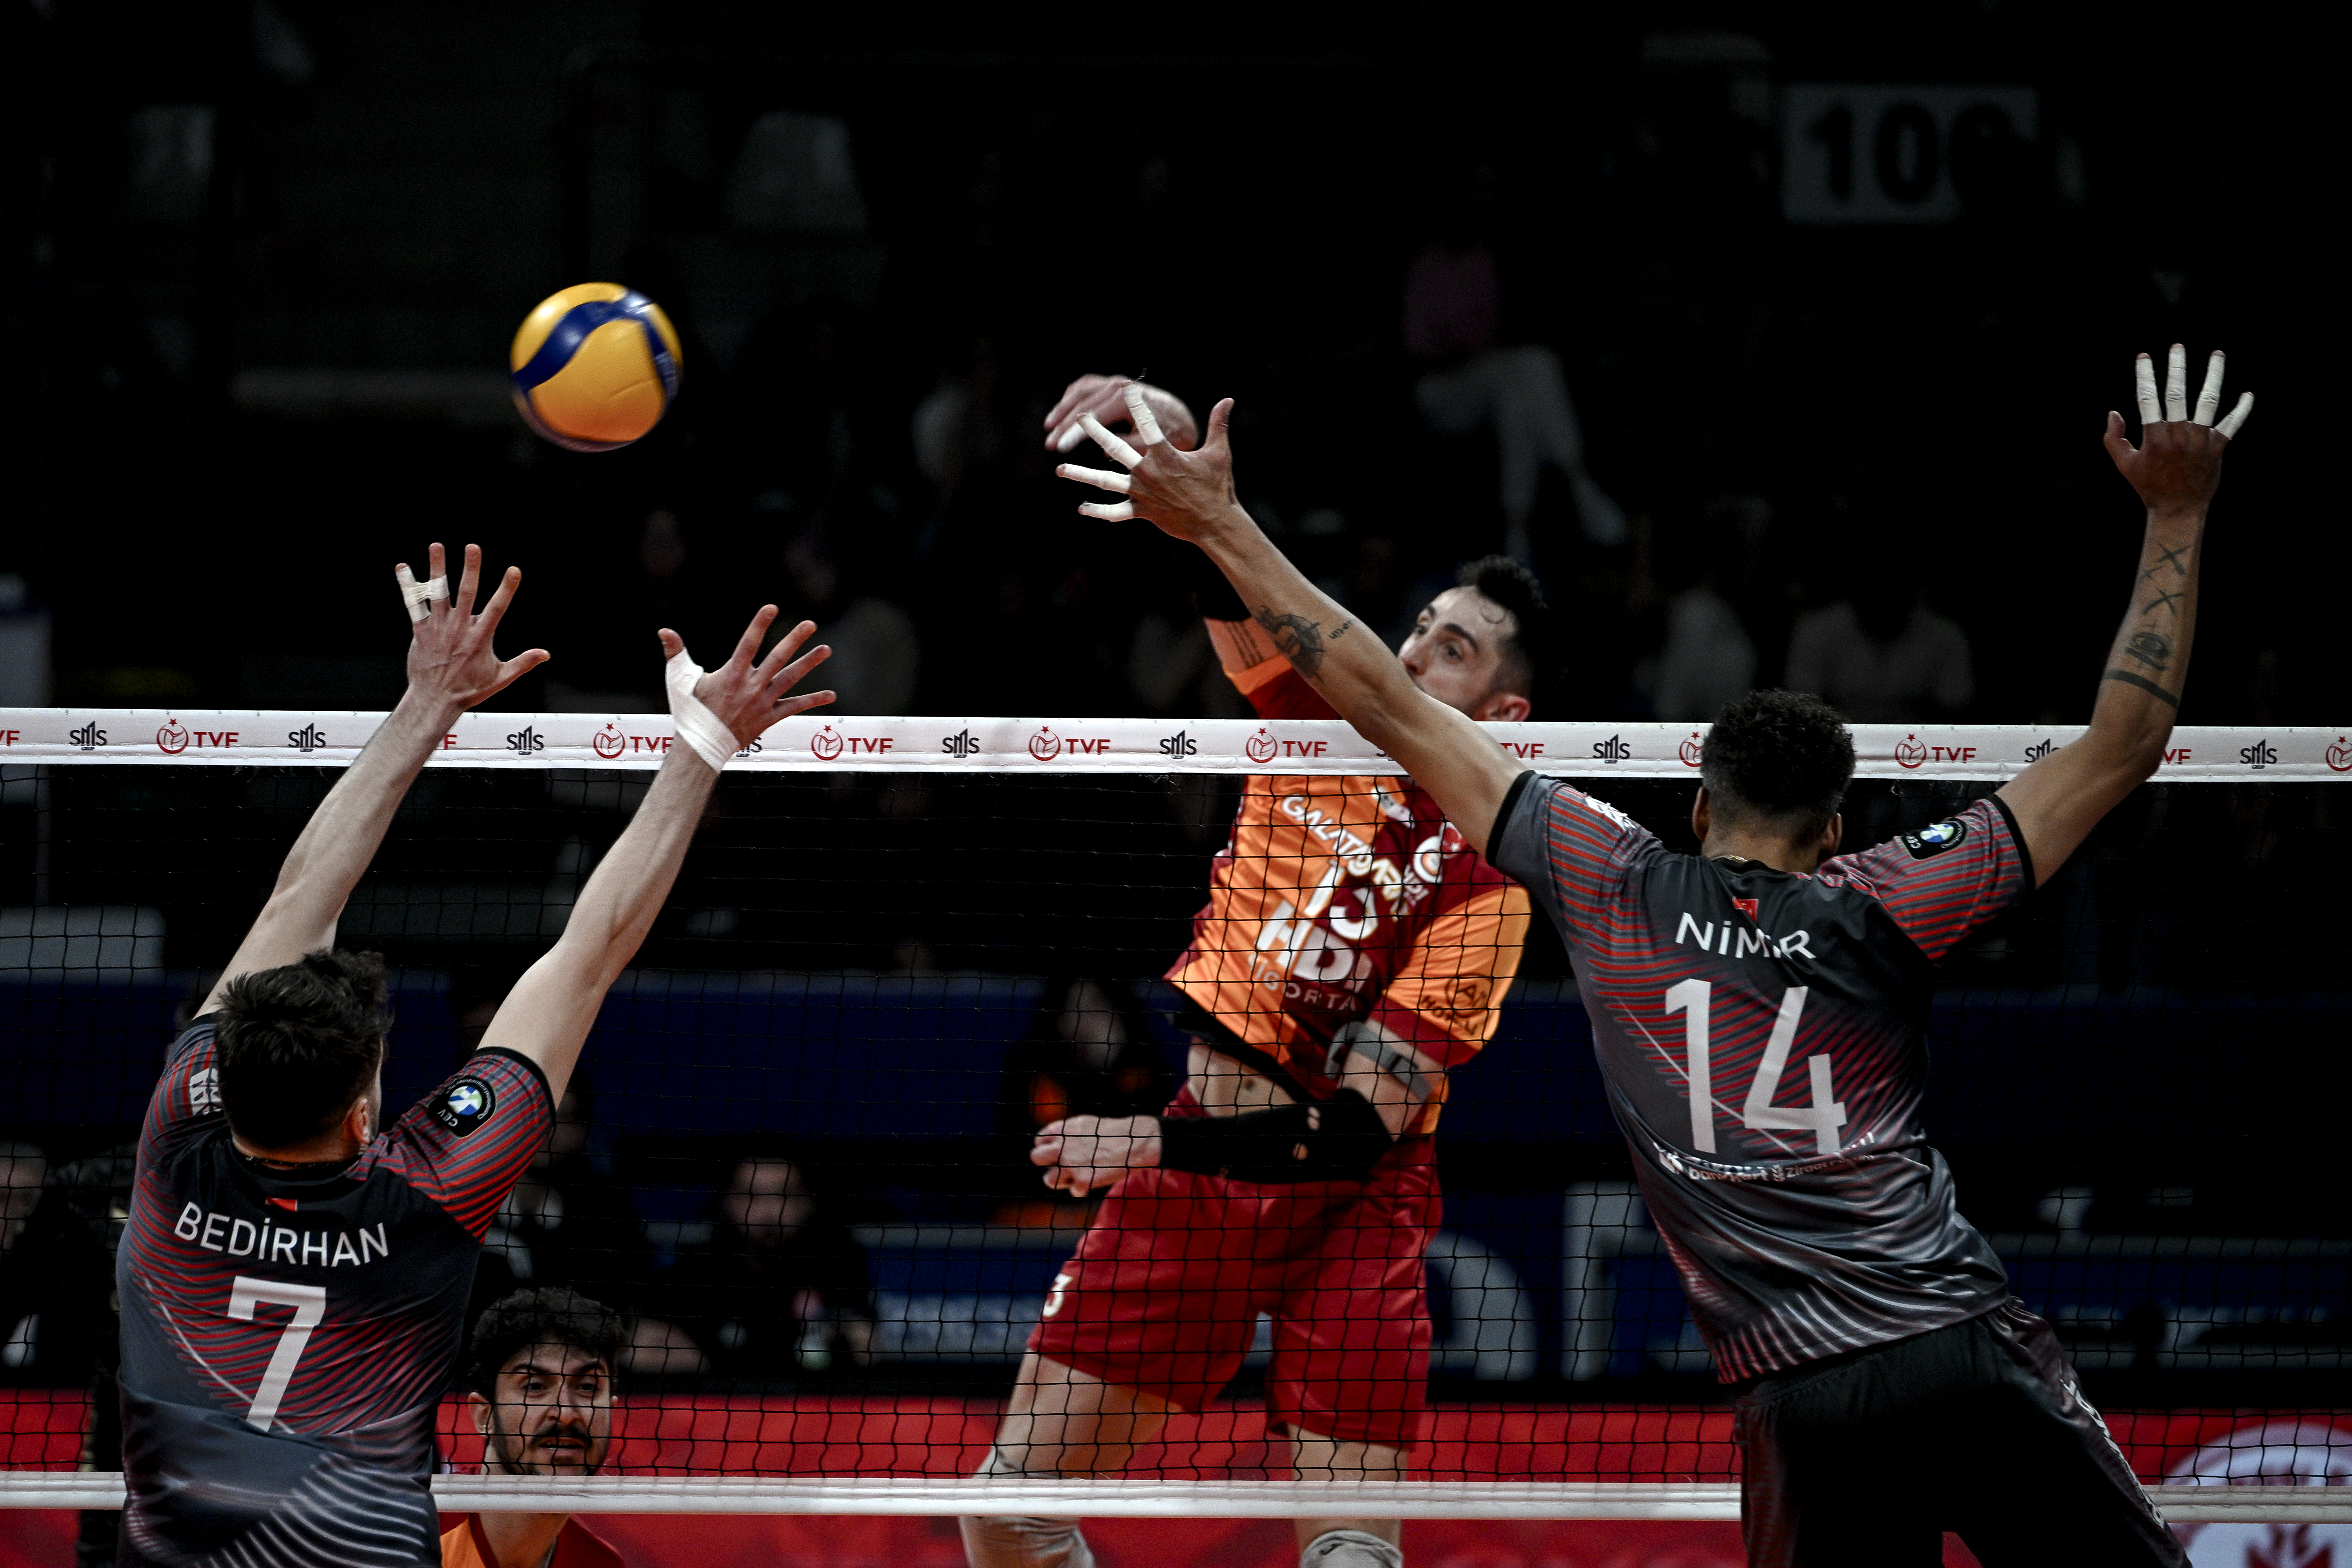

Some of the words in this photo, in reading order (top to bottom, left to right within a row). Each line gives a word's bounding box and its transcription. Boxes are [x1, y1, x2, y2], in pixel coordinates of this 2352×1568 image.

[69, 720, 108, 745] SMS
[193, 731, 239, 748] TVF
[288, 722, 326, 748] SMS
[506, 725, 544, 751] SMS
[630, 736, 674, 753] TVF
[941, 728, 980, 754] SMS
[1158, 730, 1197, 755] SMS
[848, 737, 893, 754] TVF
[1066, 739, 1110, 754] TVF
[1282, 741, 1327, 757] TVF
[1592, 734, 1631, 759] SMS
[1931, 747, 1976, 763] TVF
[2024, 738, 2060, 763] SM
[2163, 749, 2192, 764] VF
[2240, 739, 2278, 765] SMS
[1255, 900, 1372, 993] HDI
[1665, 978, 1847, 1155] 14
[437, 1109, 458, 1126] CEV
[174, 1201, 389, 1268] BEDİRHAN
[227, 1275, 326, 1433] 7
